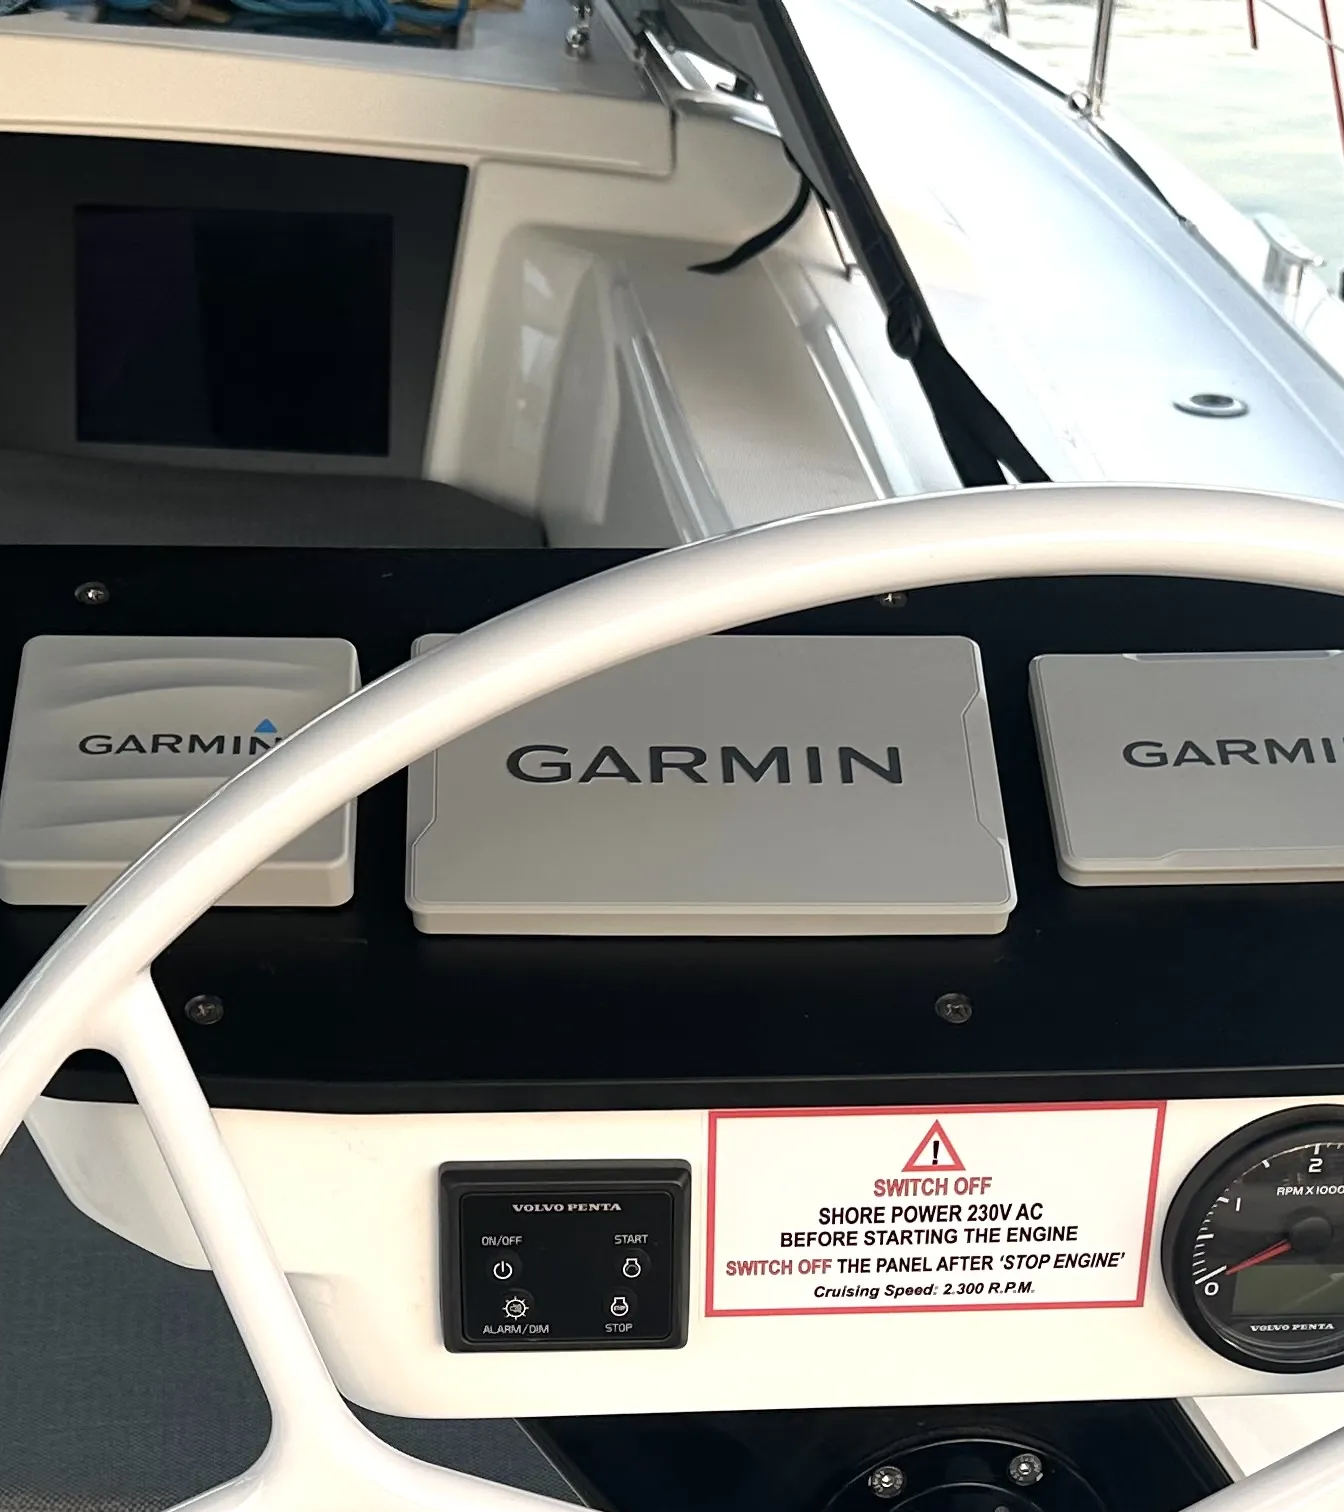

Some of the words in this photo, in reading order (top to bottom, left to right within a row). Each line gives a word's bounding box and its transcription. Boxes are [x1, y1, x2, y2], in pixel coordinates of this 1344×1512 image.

[79, 734, 288, 755] GARMIN
[506, 744, 903, 784] GARMIN
[1308, 1158, 1323, 1173] 2
[873, 1177, 948, 1197] SWITCH
[954, 1176, 992, 1195] OFF
[1276, 1186, 1305, 1196] RPM
[512, 1204, 565, 1212] VOLVO
[567, 1203, 622, 1211] PENTA
[1235, 1197, 1242, 1212] 1
[818, 1206, 886, 1225] SHORE
[891, 1204, 962, 1224] POWER
[967, 1203, 1012, 1222] 230V
[1016, 1202, 1044, 1221] AC
[481, 1236, 523, 1247] ON/OFF
[614, 1234, 649, 1245] START
[780, 1231, 858, 1248] BEFORE
[863, 1228, 957, 1246] STARTING
[964, 1227, 1001, 1243] THE
[1007, 1226, 1078, 1242] ENGINE
[725, 1260, 793, 1276] SWITCH
[798, 1258, 832, 1274] OFF
[837, 1258, 871, 1273] THE
[876, 1257, 932, 1272] PANEL
[936, 1255, 994, 1272] AFTER
[814, 1285, 880, 1299] Cruising
[884, 1283, 938, 1297] Speed:
[943, 1282, 984, 1295] 2.300
[988, 1281, 1035, 1294] R.P.M.
[1204, 1281, 1220, 1296] 0
[605, 1323, 633, 1333] STOP
[1250, 1324, 1290, 1332] VOLVO
[1291, 1323, 1335, 1331] PENTA
